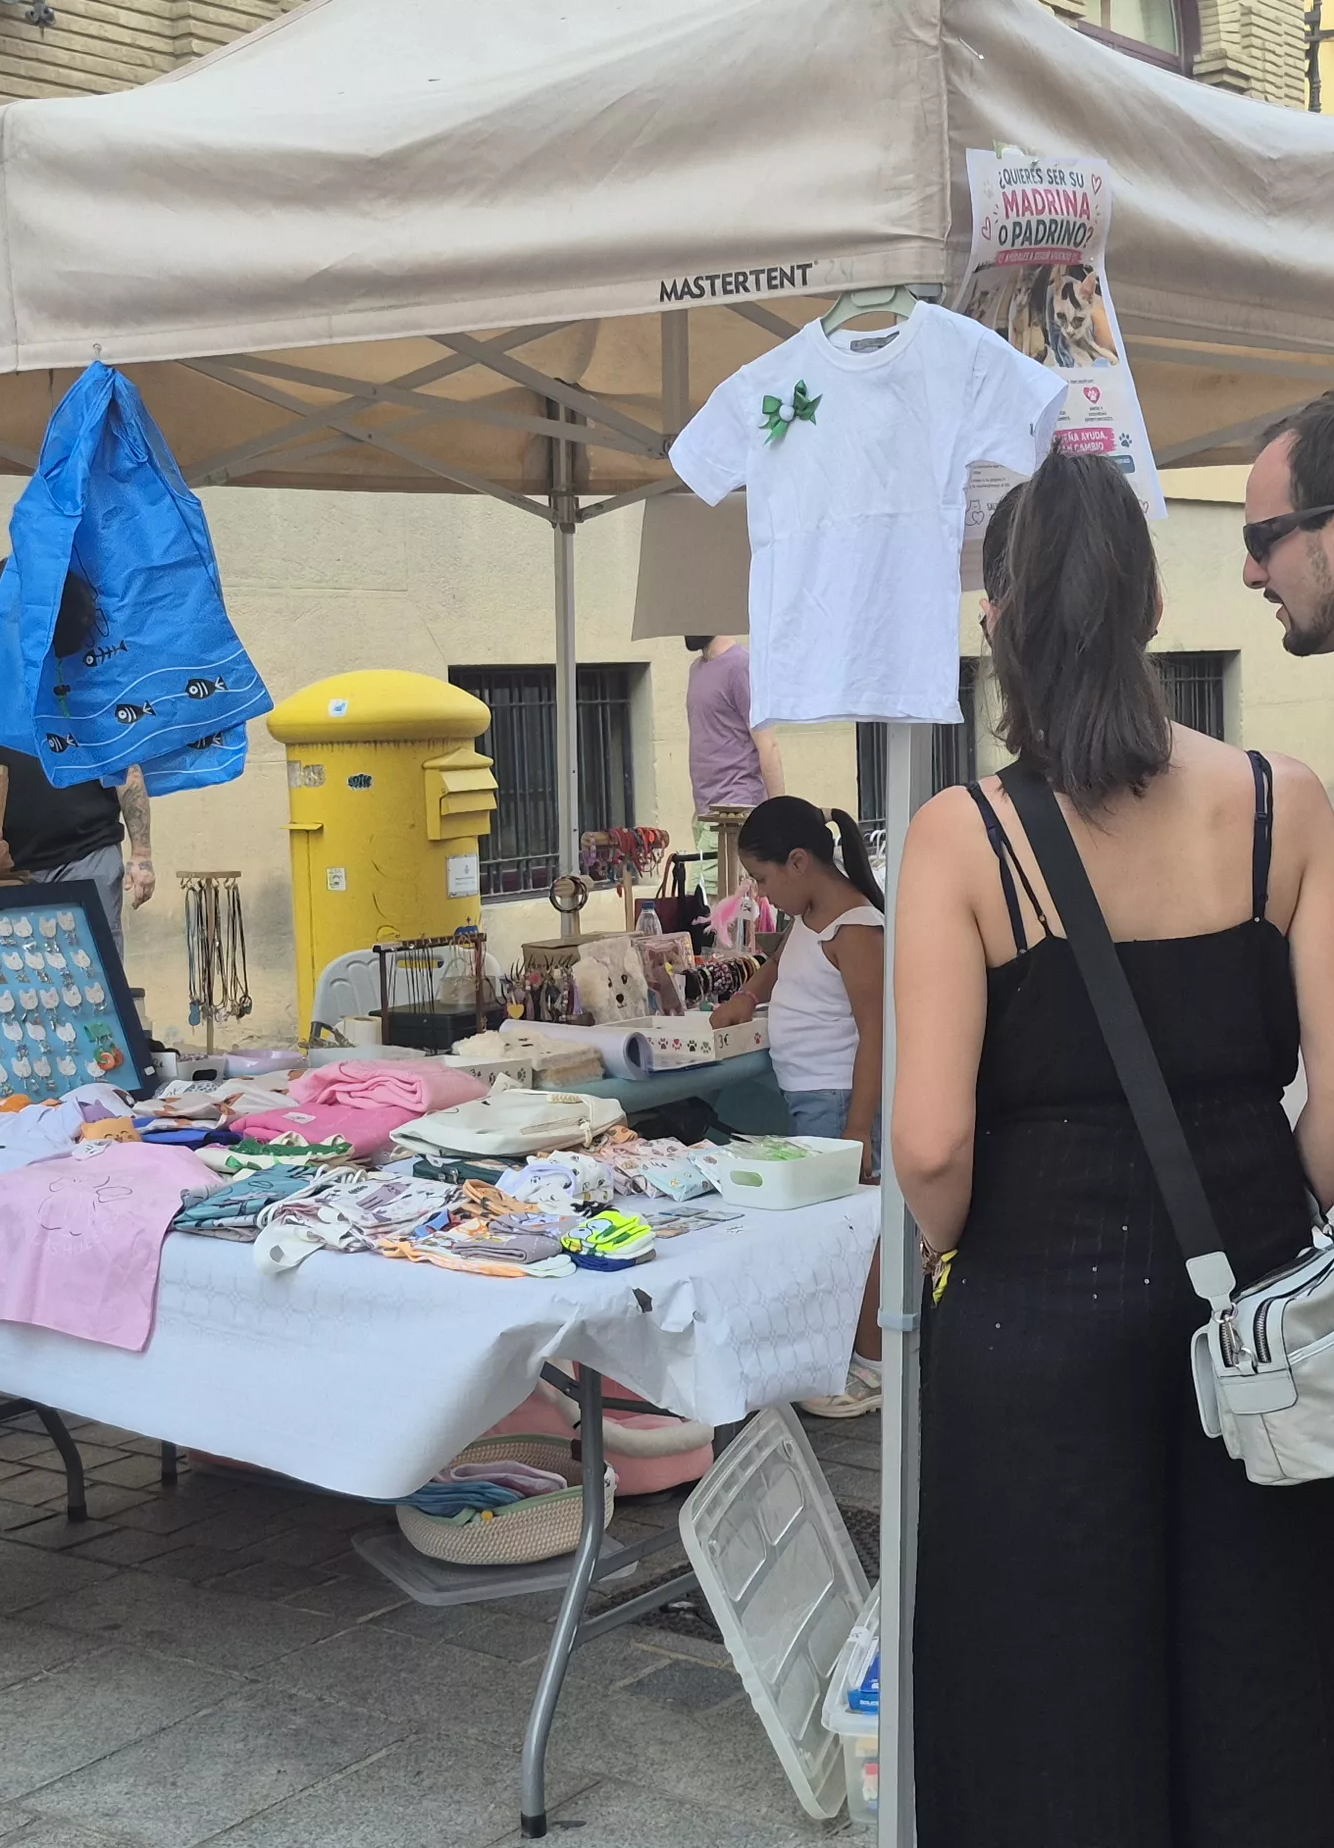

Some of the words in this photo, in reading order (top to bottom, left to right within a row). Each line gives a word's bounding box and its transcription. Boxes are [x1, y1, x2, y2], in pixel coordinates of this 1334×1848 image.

[998, 168, 1044, 189] ¿QUIERES
[1046, 168, 1068, 186] SER
[1069, 171, 1085, 188] SU
[1001, 188, 1091, 222] MADRINA
[998, 224, 1009, 246] O
[1011, 219, 1094, 249] PADRINO?
[658, 262, 813, 303] MASTERTENT
